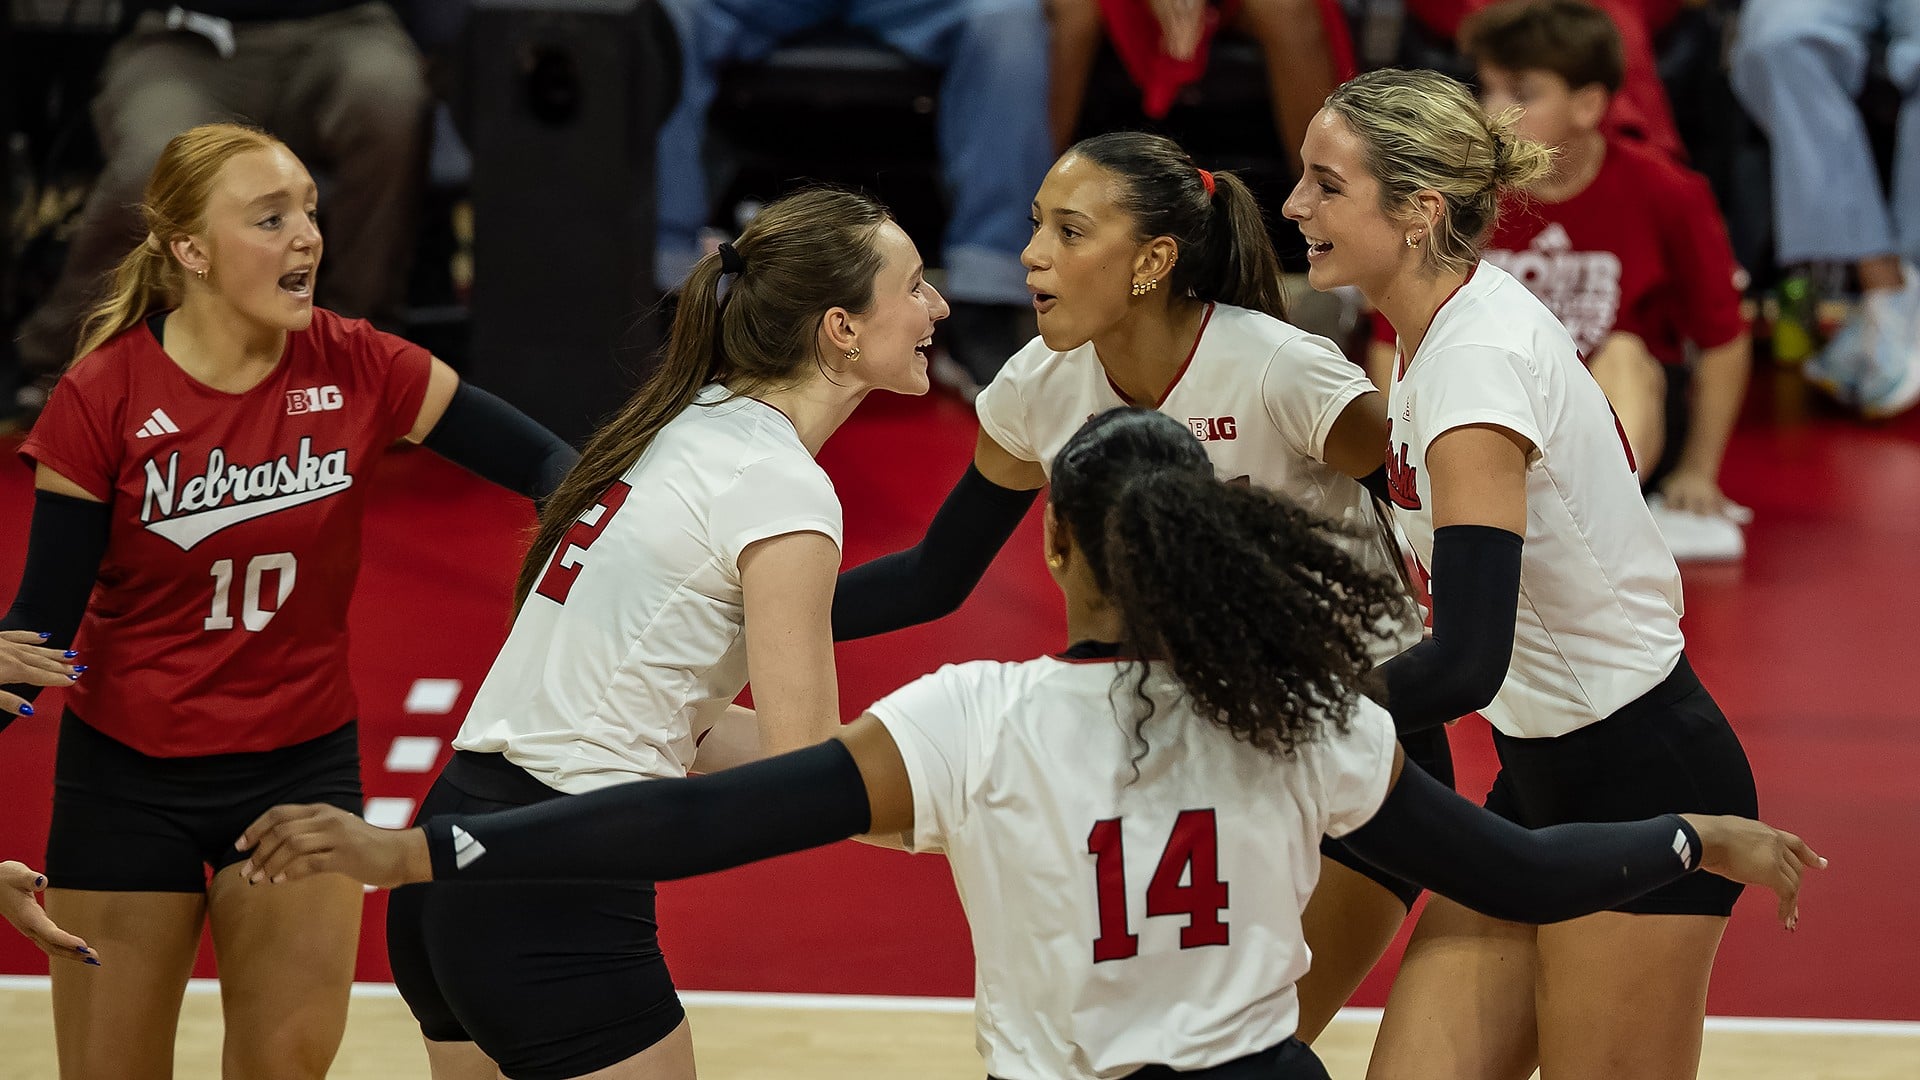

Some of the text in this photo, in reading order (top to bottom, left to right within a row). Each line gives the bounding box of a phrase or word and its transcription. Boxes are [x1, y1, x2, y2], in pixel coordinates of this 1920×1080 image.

[140, 436, 353, 523] Nebraska
[204, 552, 297, 632] 10
[1088, 808, 1230, 964] 14
